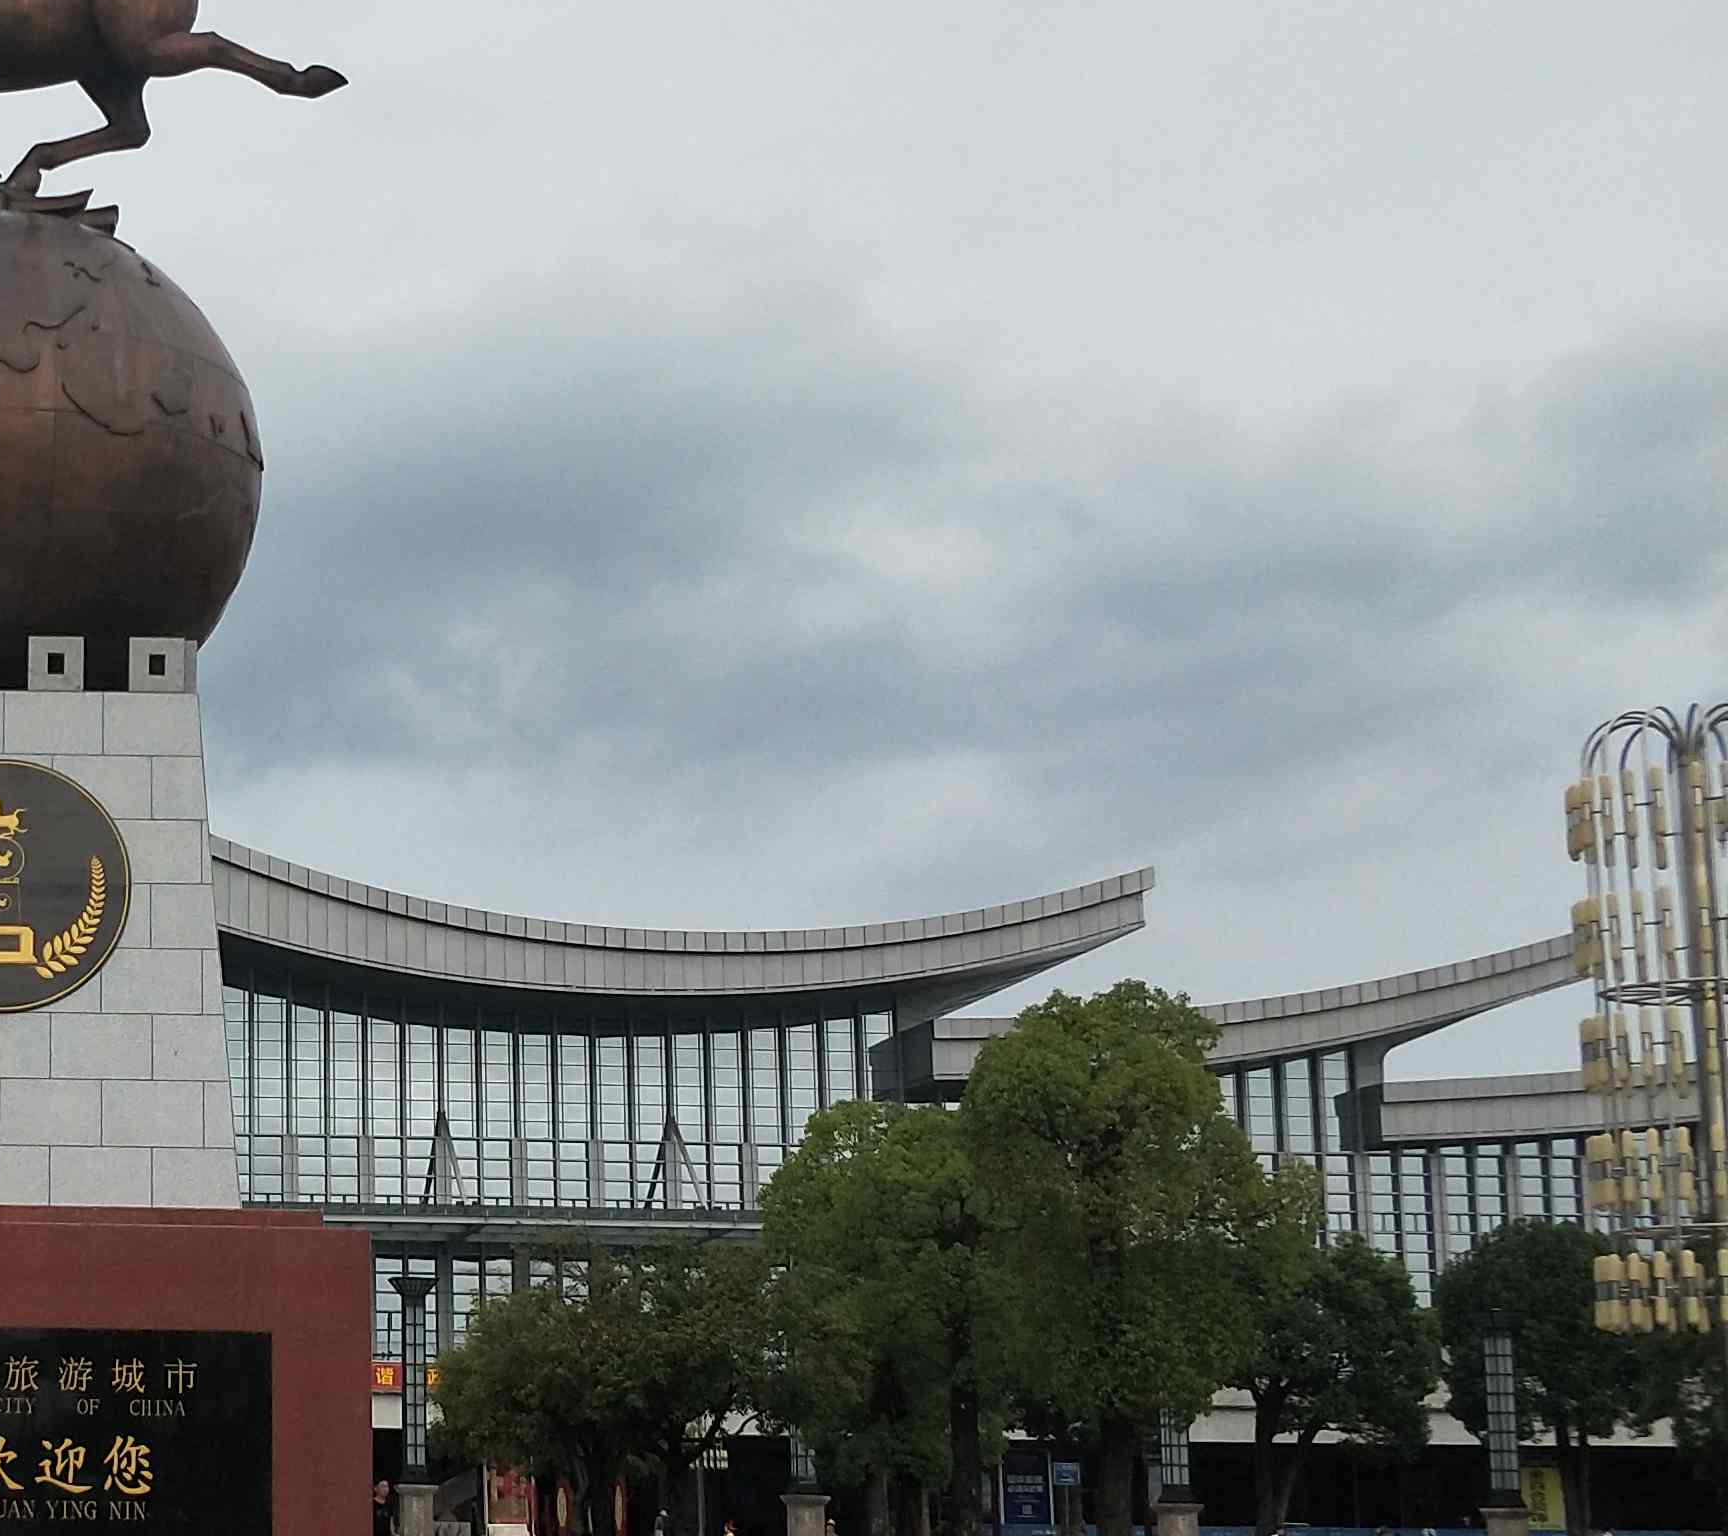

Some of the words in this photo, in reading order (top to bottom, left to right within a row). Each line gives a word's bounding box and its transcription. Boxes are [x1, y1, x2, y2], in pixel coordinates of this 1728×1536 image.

[76, 1397, 102, 1415] OF
[128, 1398, 186, 1417] CHINA
[45, 1499, 98, 1520] YING
[108, 1501, 147, 1521] NIN
